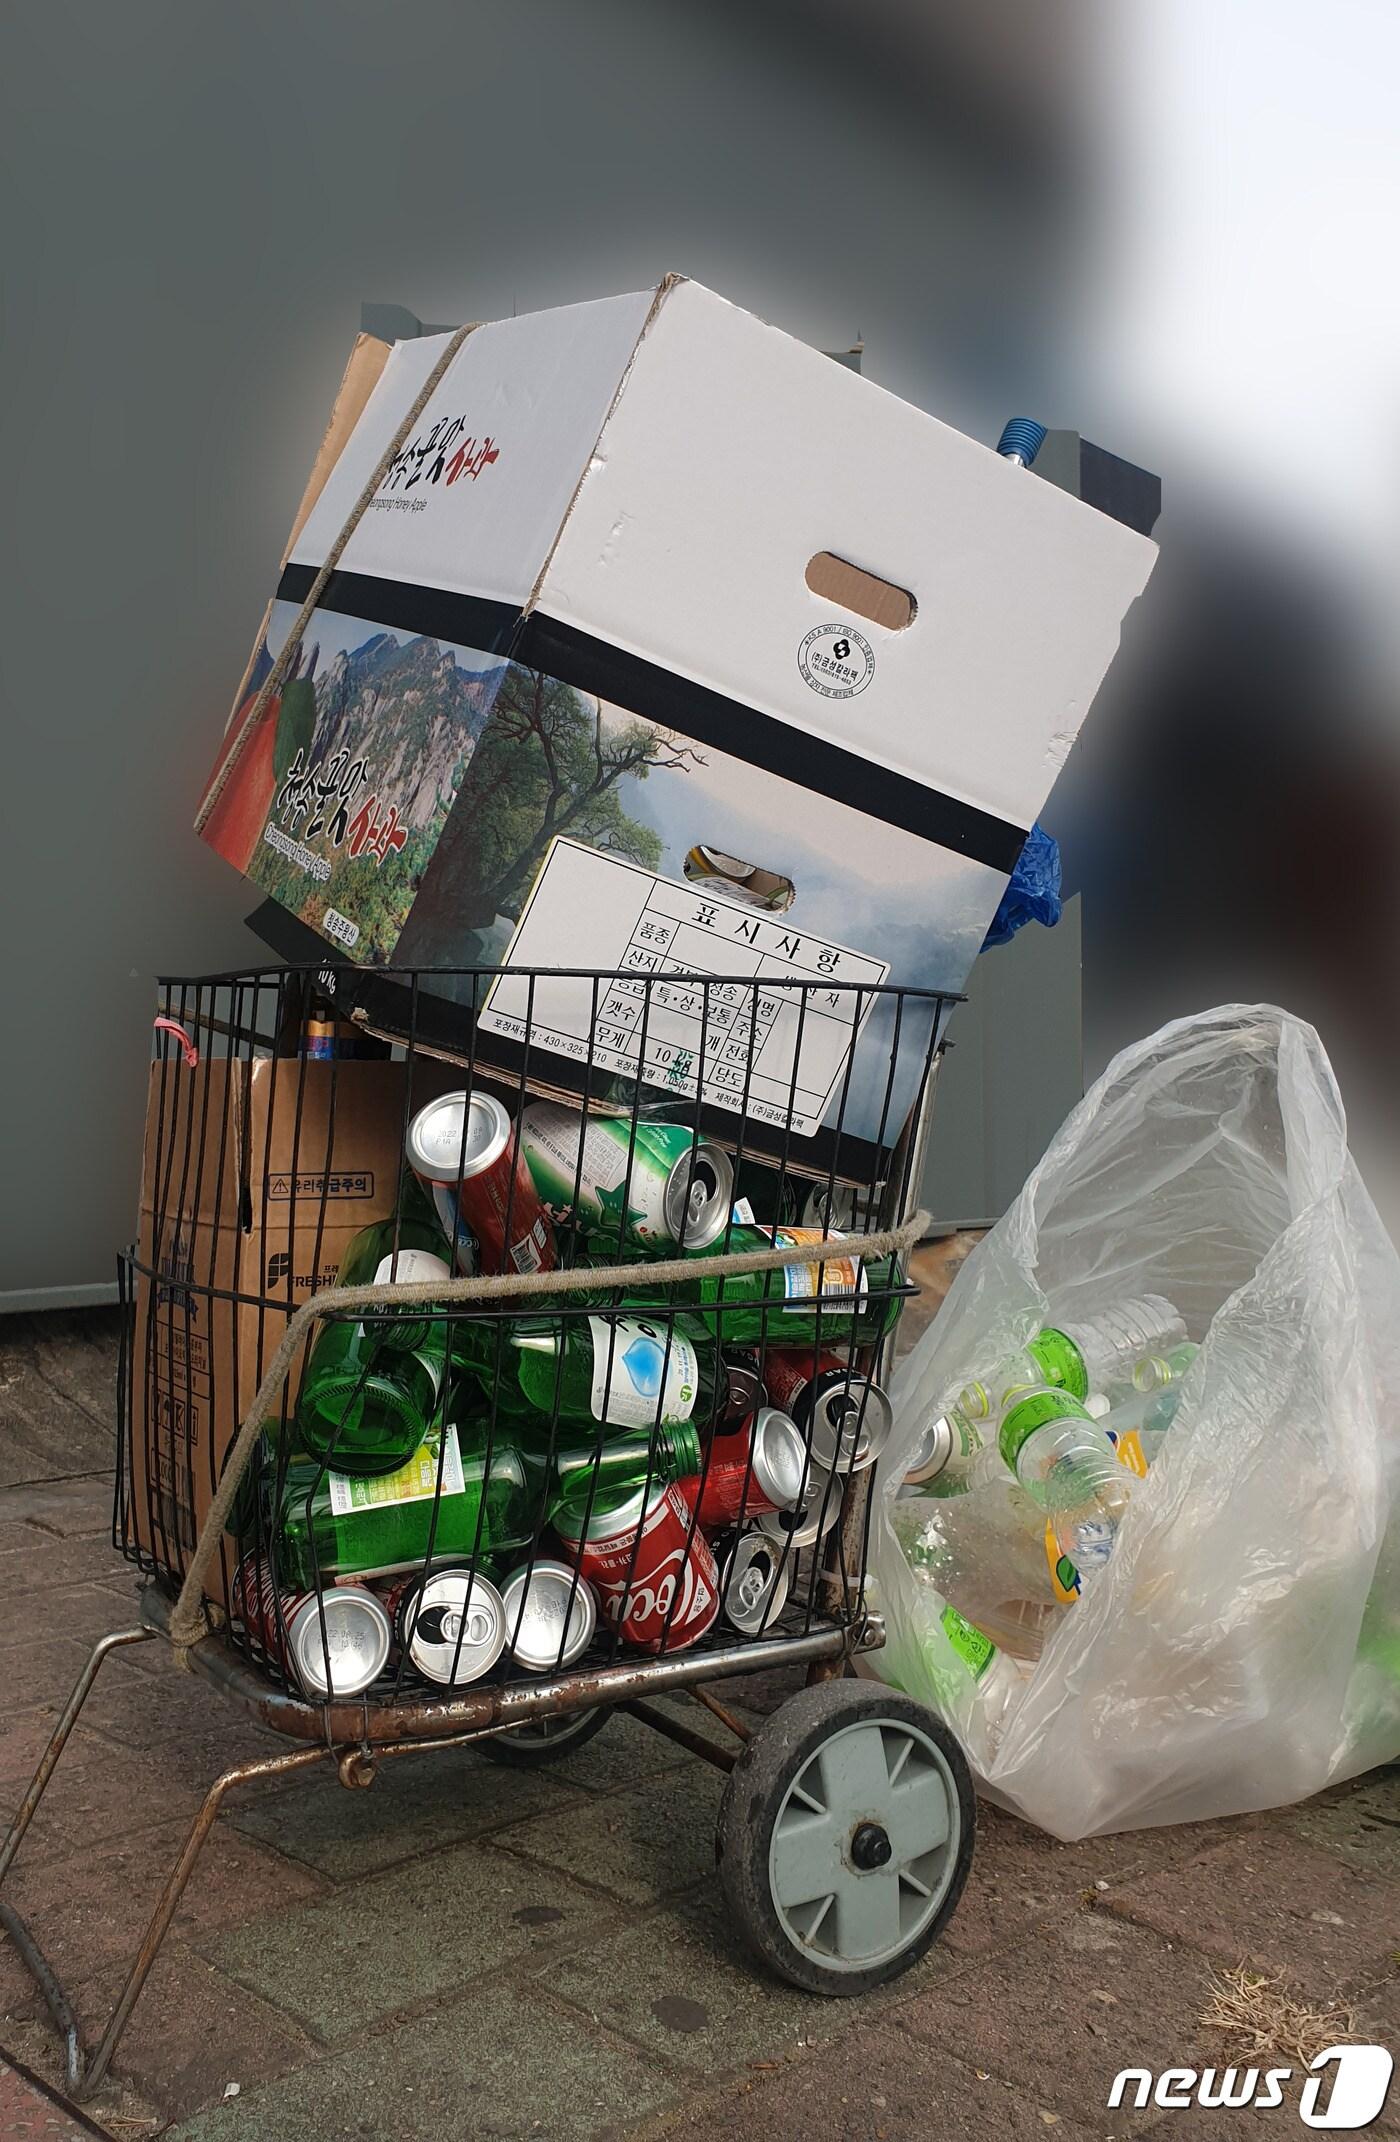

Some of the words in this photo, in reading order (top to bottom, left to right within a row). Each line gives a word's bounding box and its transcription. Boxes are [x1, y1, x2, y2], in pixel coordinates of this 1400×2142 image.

[640, 922, 671, 945] 품종
[628, 950, 659, 973] 산지
[605, 1000, 636, 1021] 갯수
[596, 1026, 626, 1053] 무게
[715, 1066, 743, 1088] 당도
